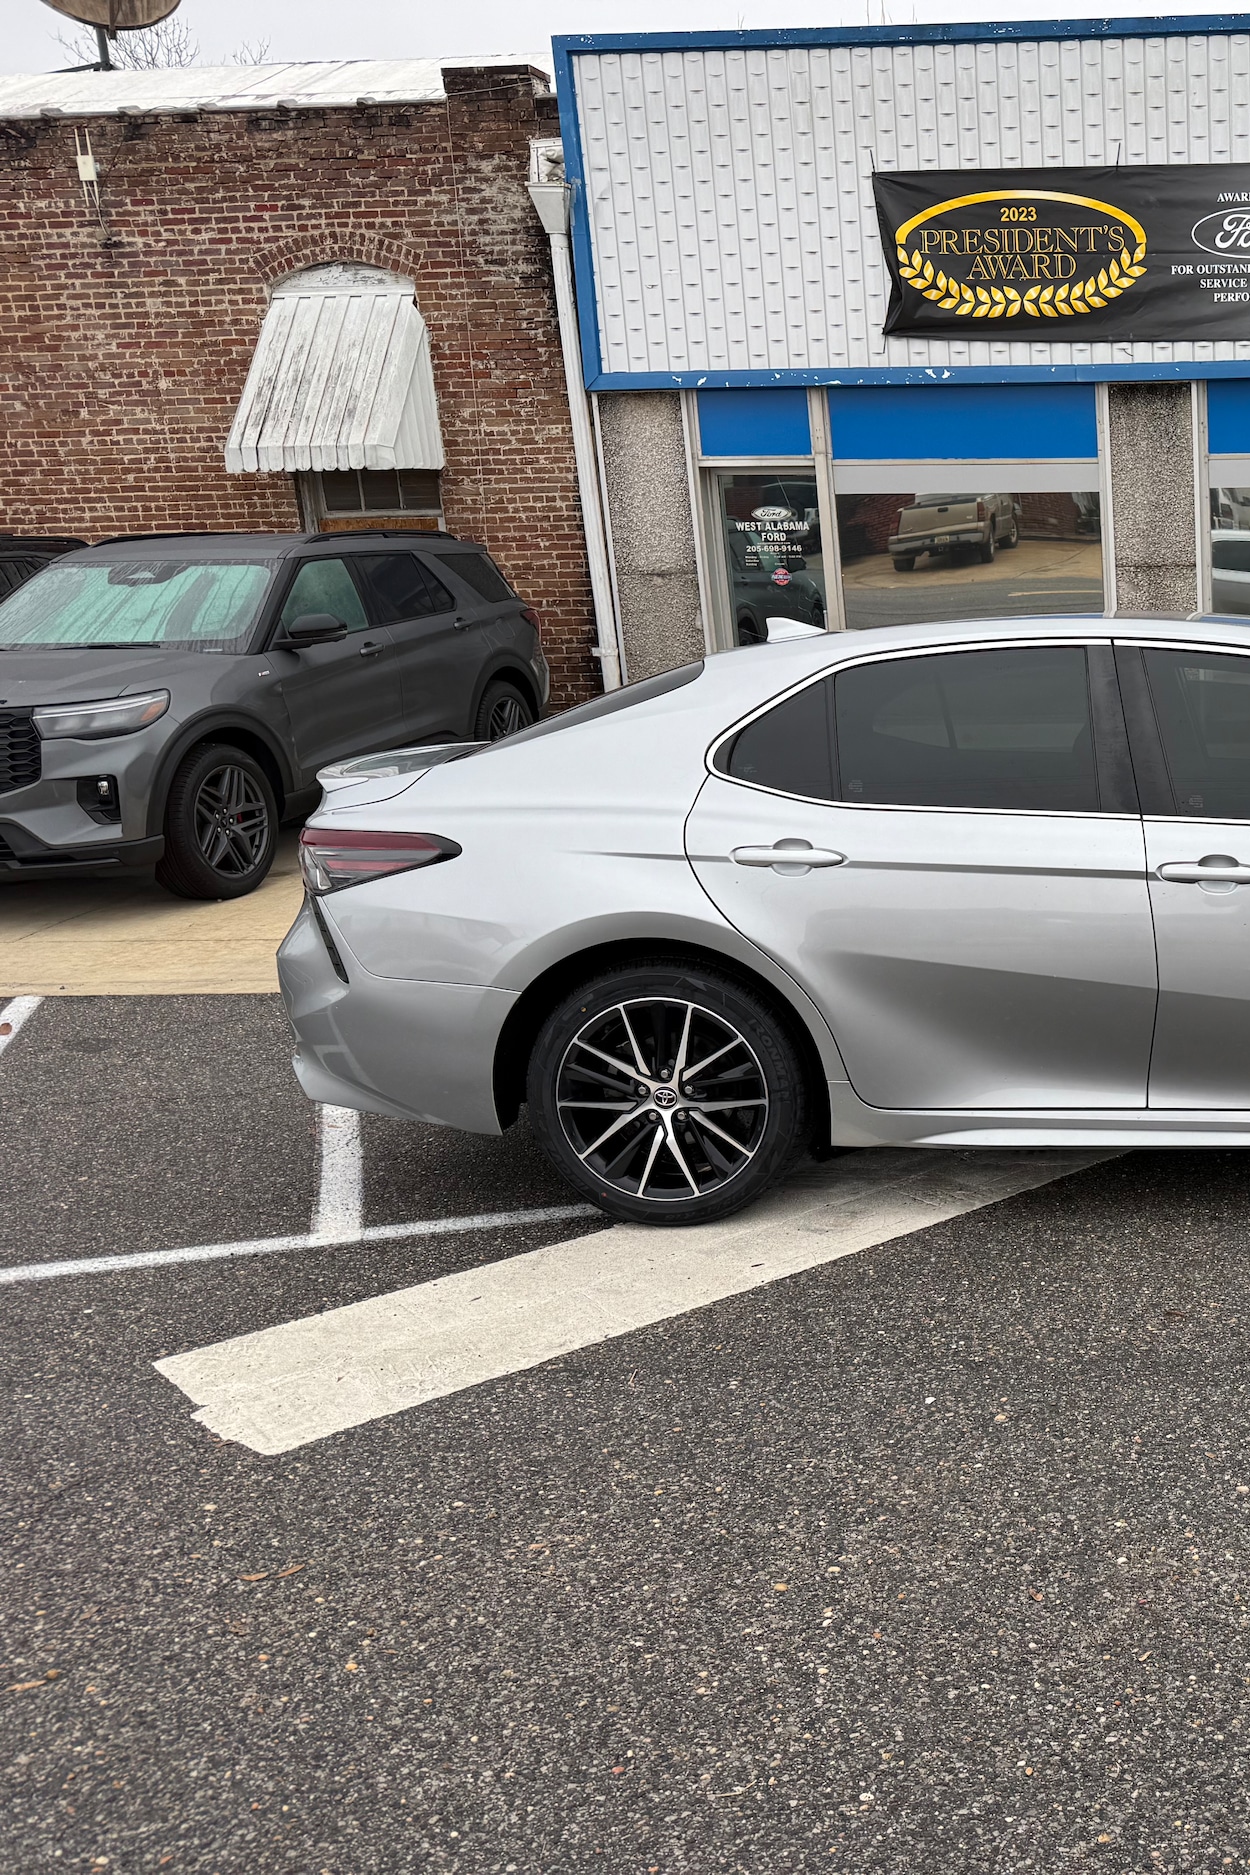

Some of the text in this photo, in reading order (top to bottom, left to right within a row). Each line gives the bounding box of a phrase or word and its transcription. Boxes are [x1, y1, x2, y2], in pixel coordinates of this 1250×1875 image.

[1000, 207, 1037, 222] 2023
[919, 225, 1125, 255] PRESIDENT'S
[966, 254, 1077, 280] AWARD
[1171, 265, 1193, 275] FOR
[1200, 278, 1248, 289] SERVICE
[736, 521, 810, 531] WEST ALABAMA
[761, 533, 787, 541] FORD
[746, 545, 802, 553] 205-698-9146
